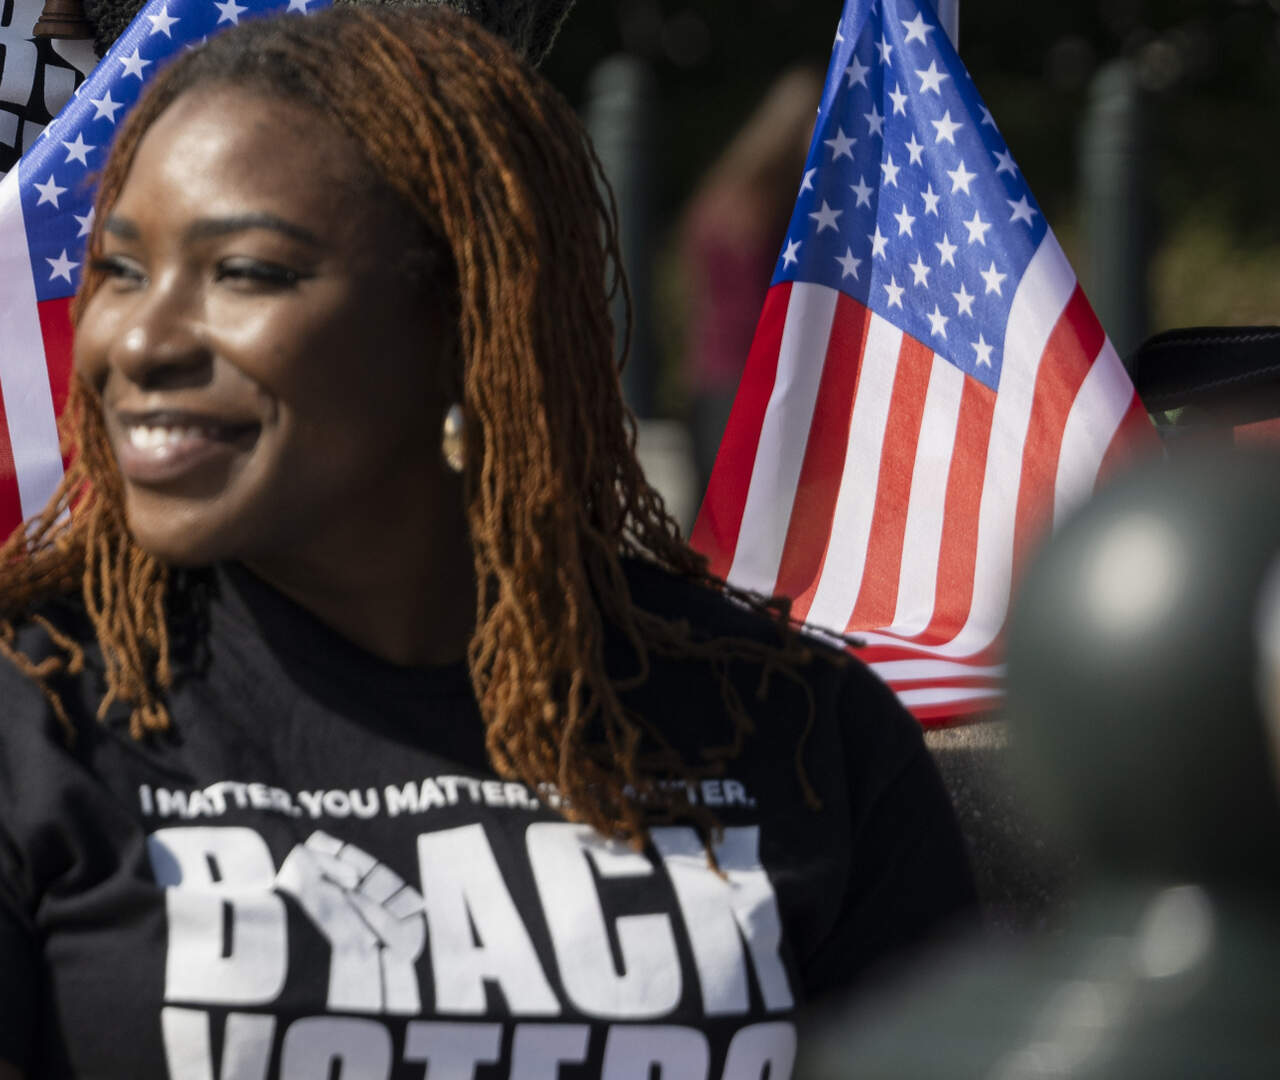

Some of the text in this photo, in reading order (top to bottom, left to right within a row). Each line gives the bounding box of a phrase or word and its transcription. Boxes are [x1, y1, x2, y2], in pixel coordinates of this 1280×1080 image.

[140, 784, 153, 816] I
[156, 780, 302, 818] MATTER.
[298, 787, 379, 818] YOU
[385, 775, 538, 818] MATTER.
